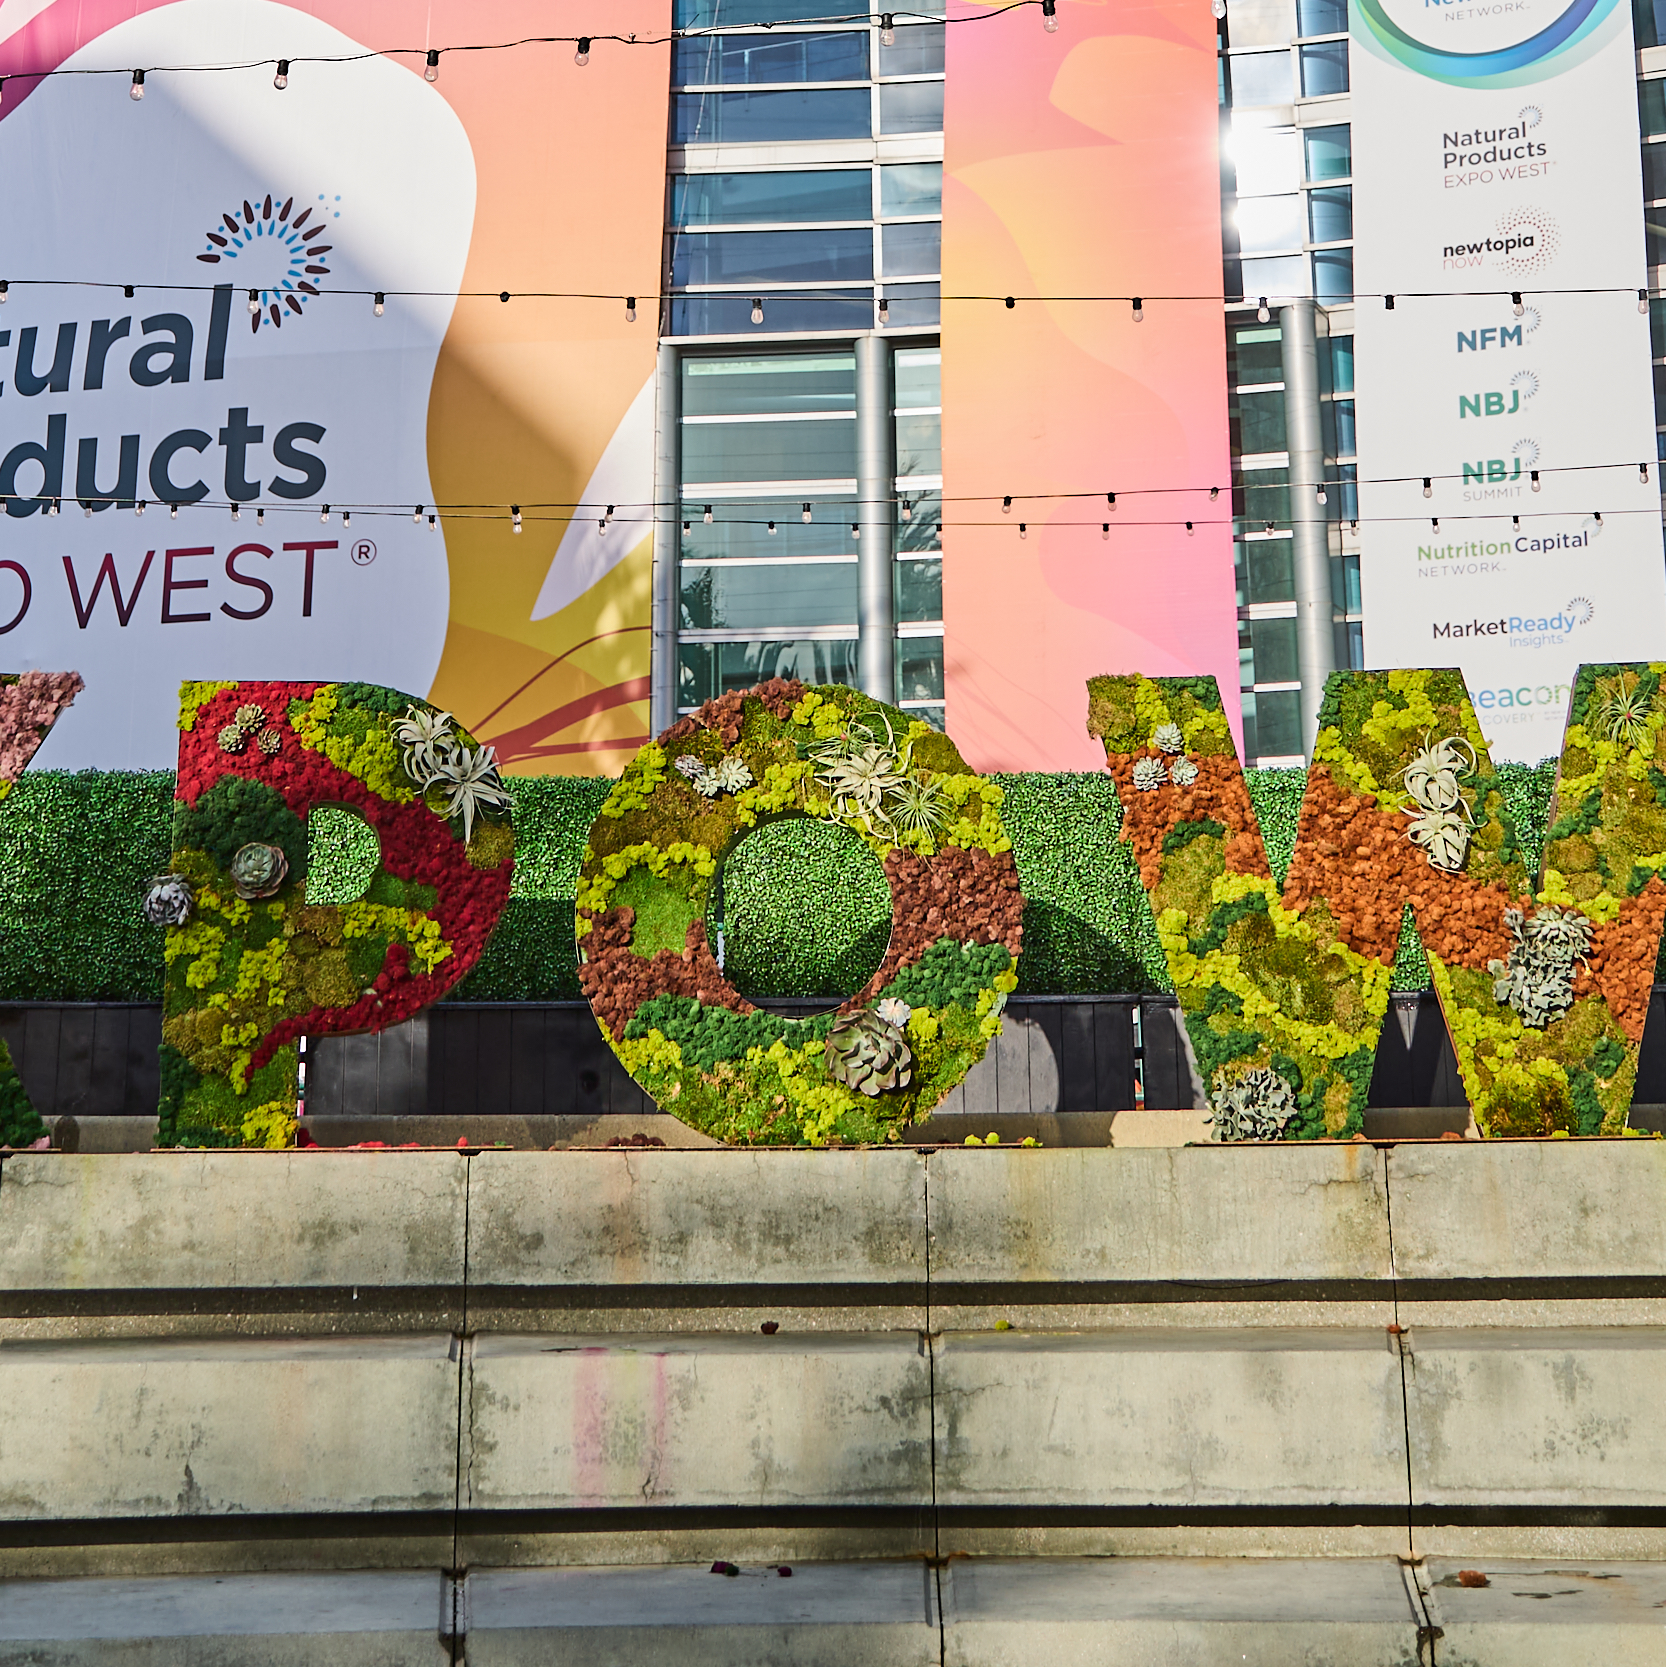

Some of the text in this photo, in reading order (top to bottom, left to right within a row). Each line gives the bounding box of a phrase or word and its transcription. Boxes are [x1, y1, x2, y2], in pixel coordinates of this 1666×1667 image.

[1445, 1, 1525, 22] NETWORK
[1443, 121, 1527, 149] Natural
[1443, 142, 1547, 169] Products
[1444, 161, 1550, 188] EXPO WEST
[1443, 233, 1535, 257] newtopia
[1443, 255, 1484, 270] now
[1457, 324, 1523, 353] NFM
[1459, 389, 1520, 419] NBJ
[1462, 457, 1521, 486] NBJ
[1463, 486, 1523, 502] SUMMIT
[1418, 561, 1500, 578] NETWORK
[1509, 634, 1564, 649] Insights
[1478, 713, 1535, 725] COVERY
